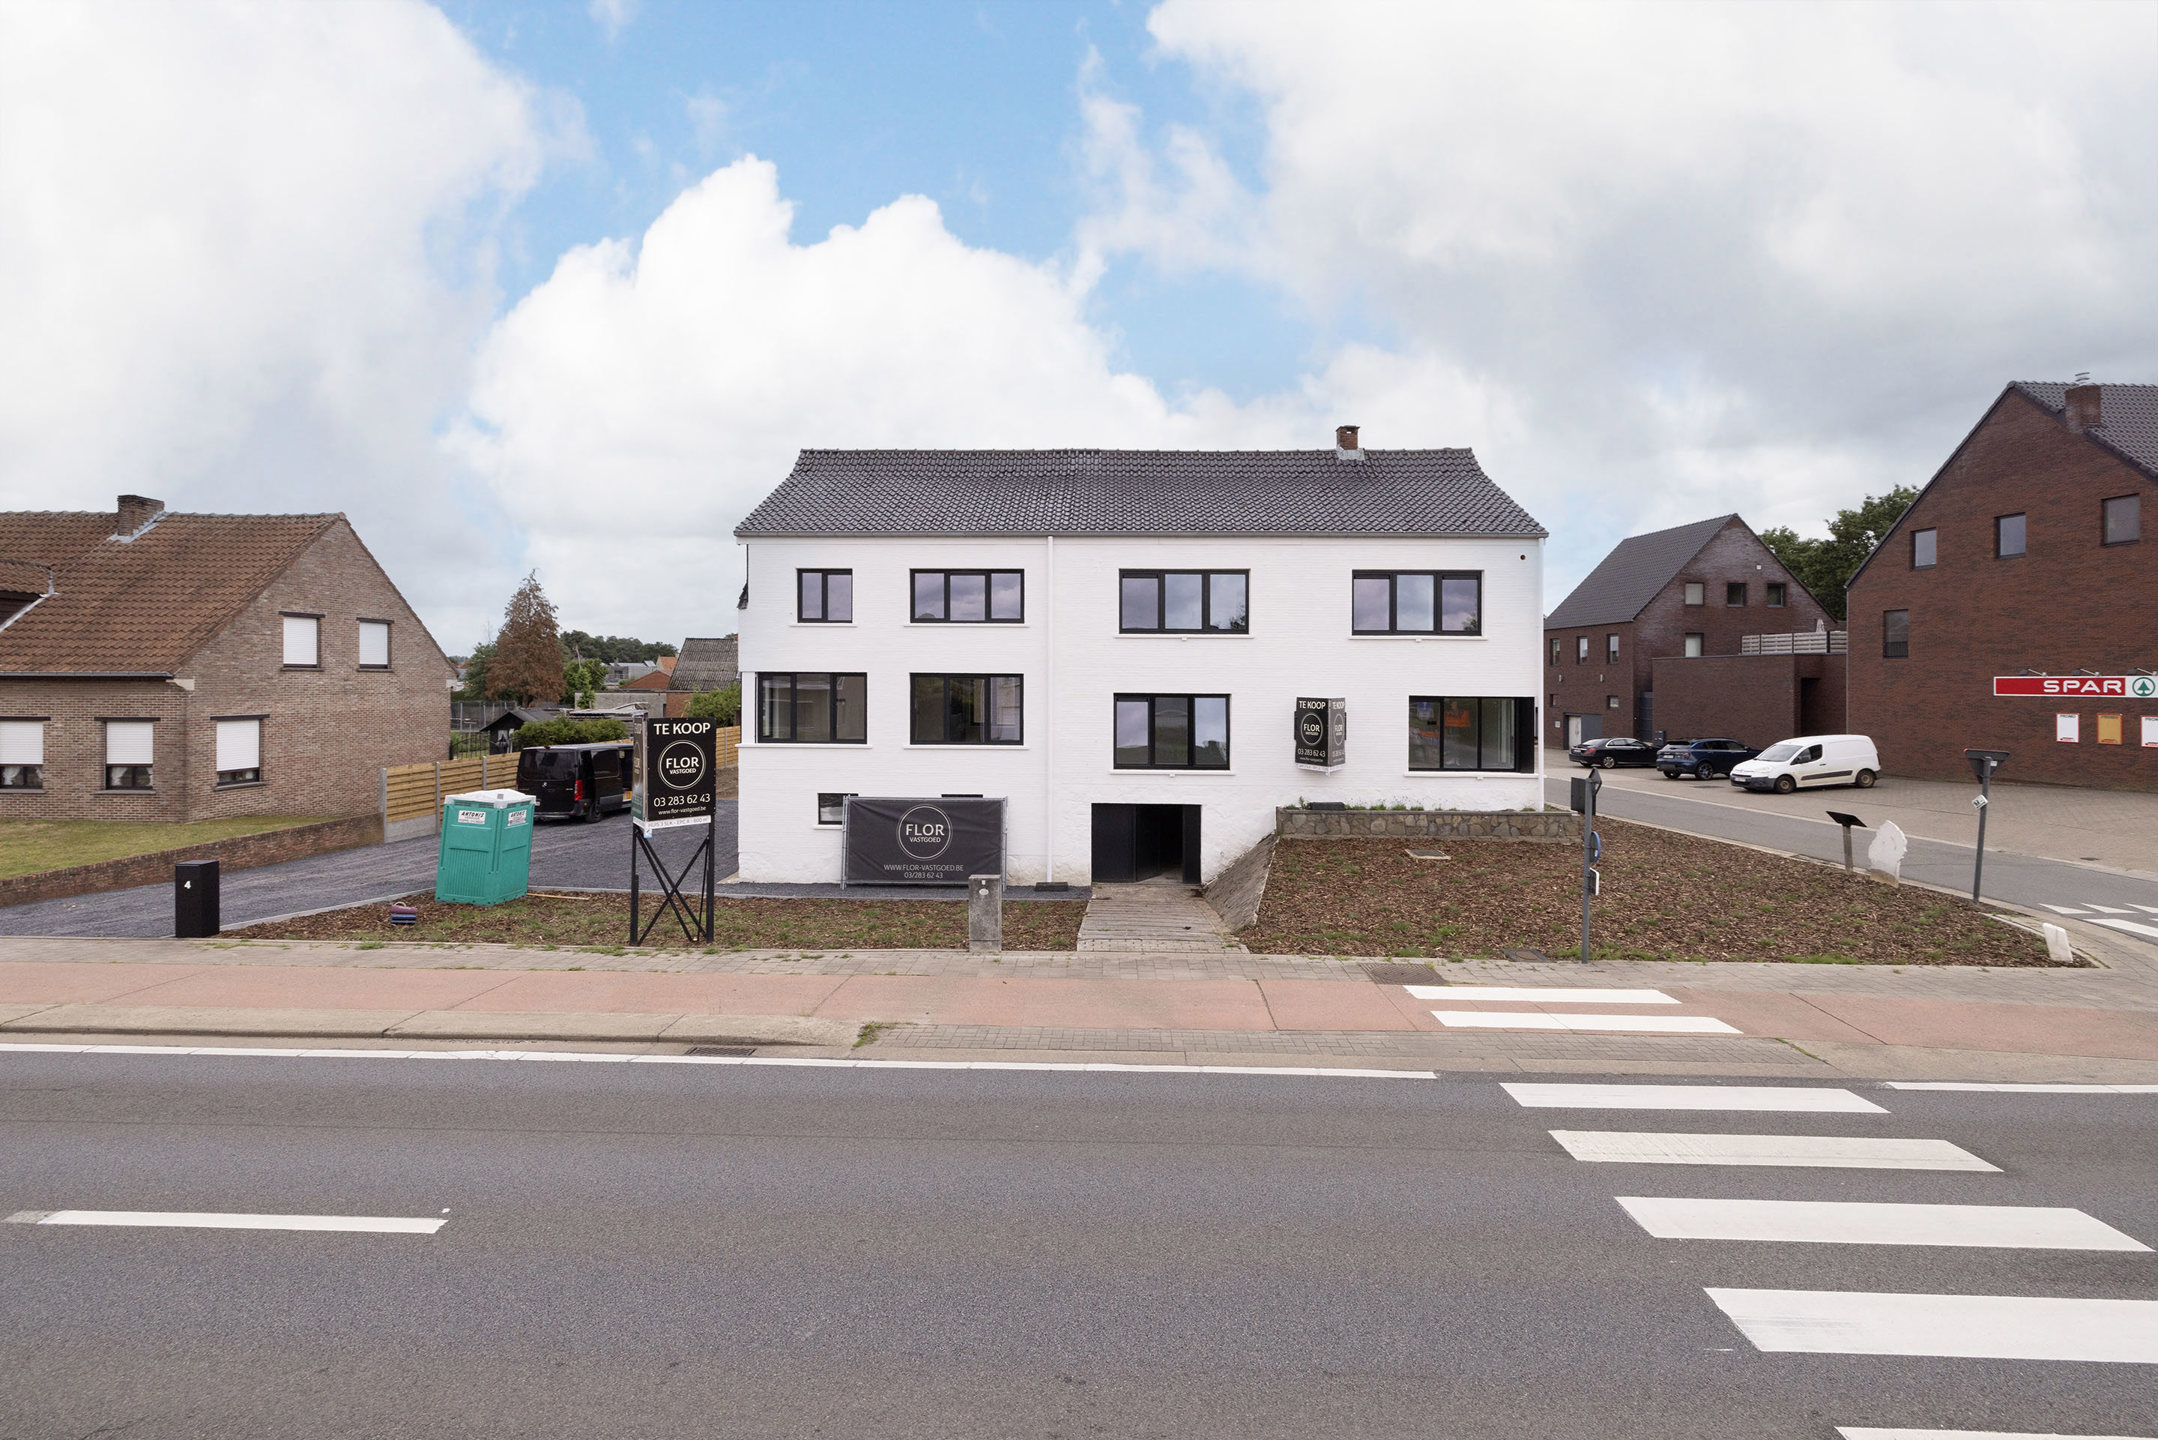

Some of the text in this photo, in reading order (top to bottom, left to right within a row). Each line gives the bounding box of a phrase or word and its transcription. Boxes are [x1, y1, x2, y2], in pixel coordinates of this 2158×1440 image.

[2043, 680, 2122, 694] SPAR
[1299, 700, 1326, 710] TE KOOP
[653, 723, 670, 735] TE
[672, 722, 711, 735] KOOP
[1303, 723, 1320, 732] FLOR
[1304, 748, 1313, 756] 283
[1319, 750, 1326, 758] 43
[665, 756, 699, 769] FLOR
[653, 797, 666, 807] 03
[667, 795, 685, 806] 283
[686, 794, 698, 804] 62
[699, 793, 711, 803] 43
[905, 823, 945, 836] FLOR
[883, 864, 964, 872] WWW.FLOR-VASTGOED.BE
[903, 871, 943, 879] 03/283 62 43
[184, 880, 191, 889] 4
